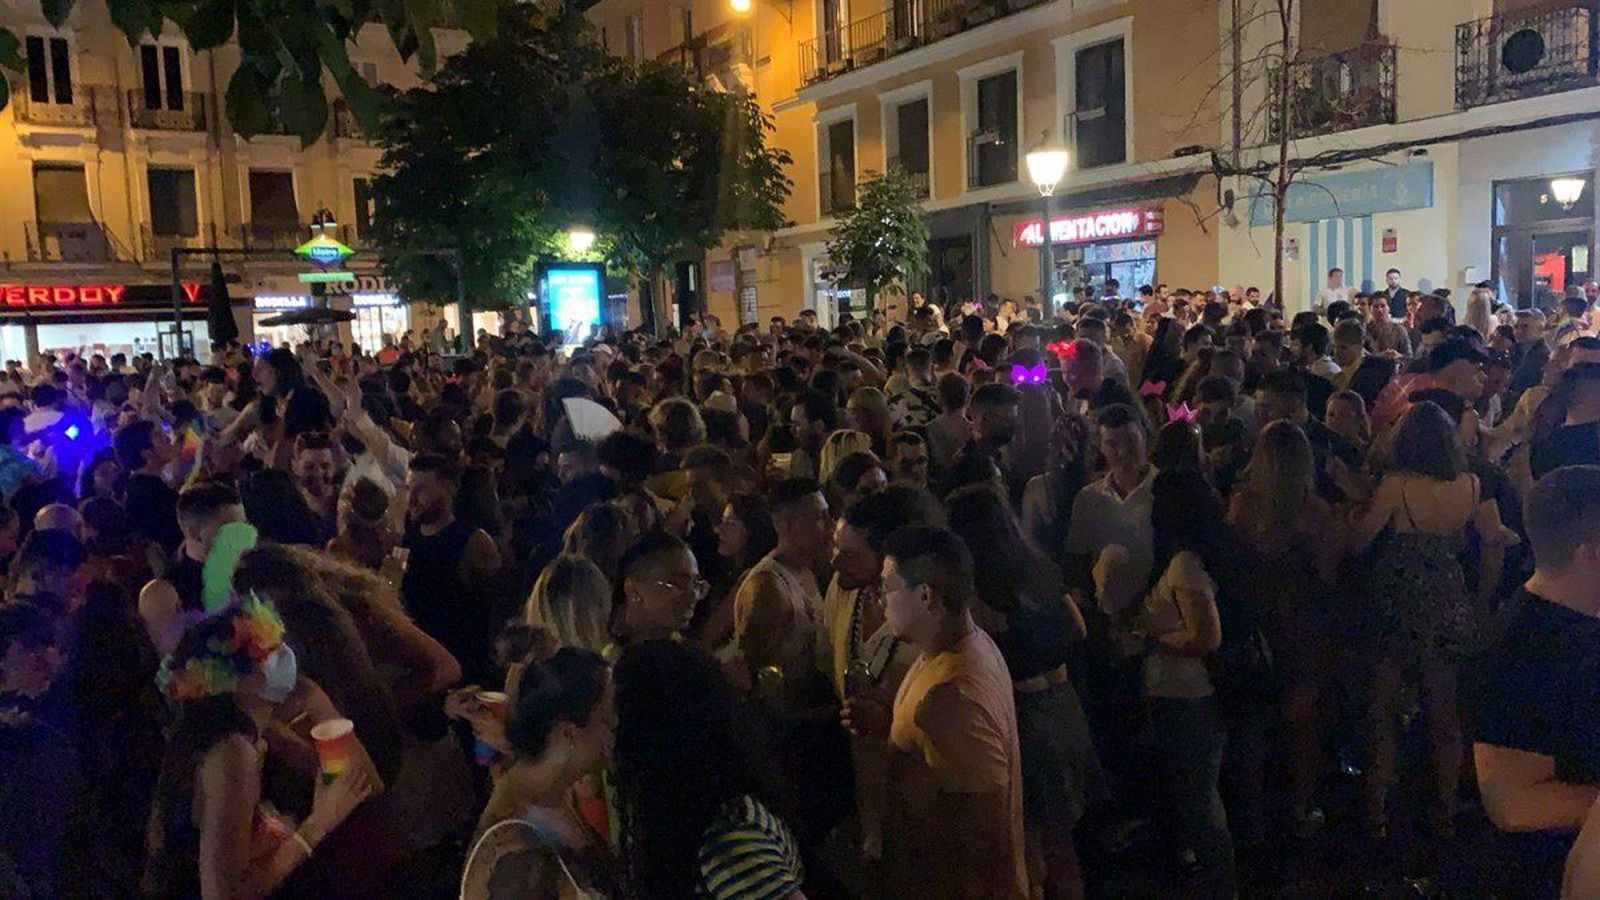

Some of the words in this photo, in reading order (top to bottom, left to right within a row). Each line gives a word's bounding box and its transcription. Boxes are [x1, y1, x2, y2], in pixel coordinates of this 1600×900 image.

[1540, 194, 1548, 204] 5
[1020, 212, 1134, 245] ALMENTACION
[312, 248, 338, 257] Metro
[0, 286, 125, 305] ERDOY
[181, 283, 201, 303] V
